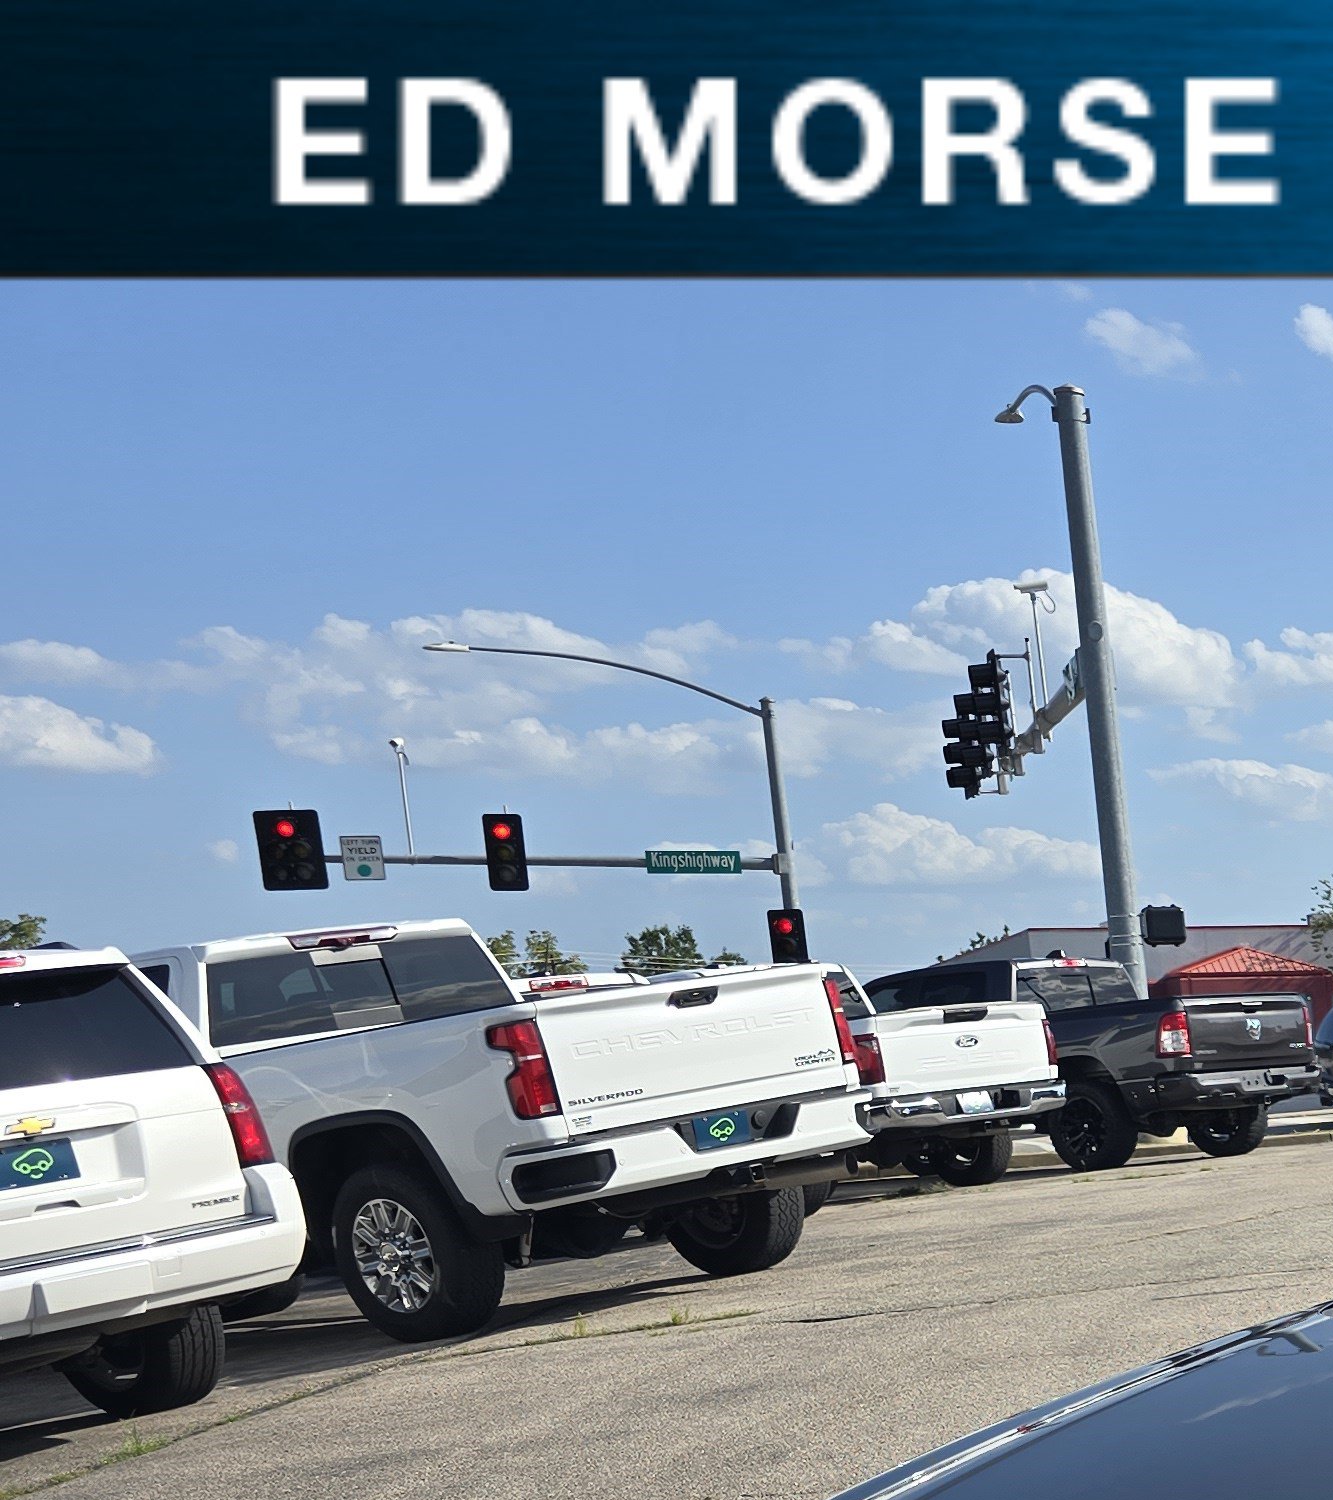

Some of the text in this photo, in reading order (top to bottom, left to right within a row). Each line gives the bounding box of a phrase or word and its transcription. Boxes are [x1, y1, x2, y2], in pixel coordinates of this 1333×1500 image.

[347, 847, 377, 855] YIELD
[650, 852, 736, 872] Kingshighway
[570, 1007, 816, 1060] CHEVROLET
[568, 1089, 644, 1107] SILVERADO
